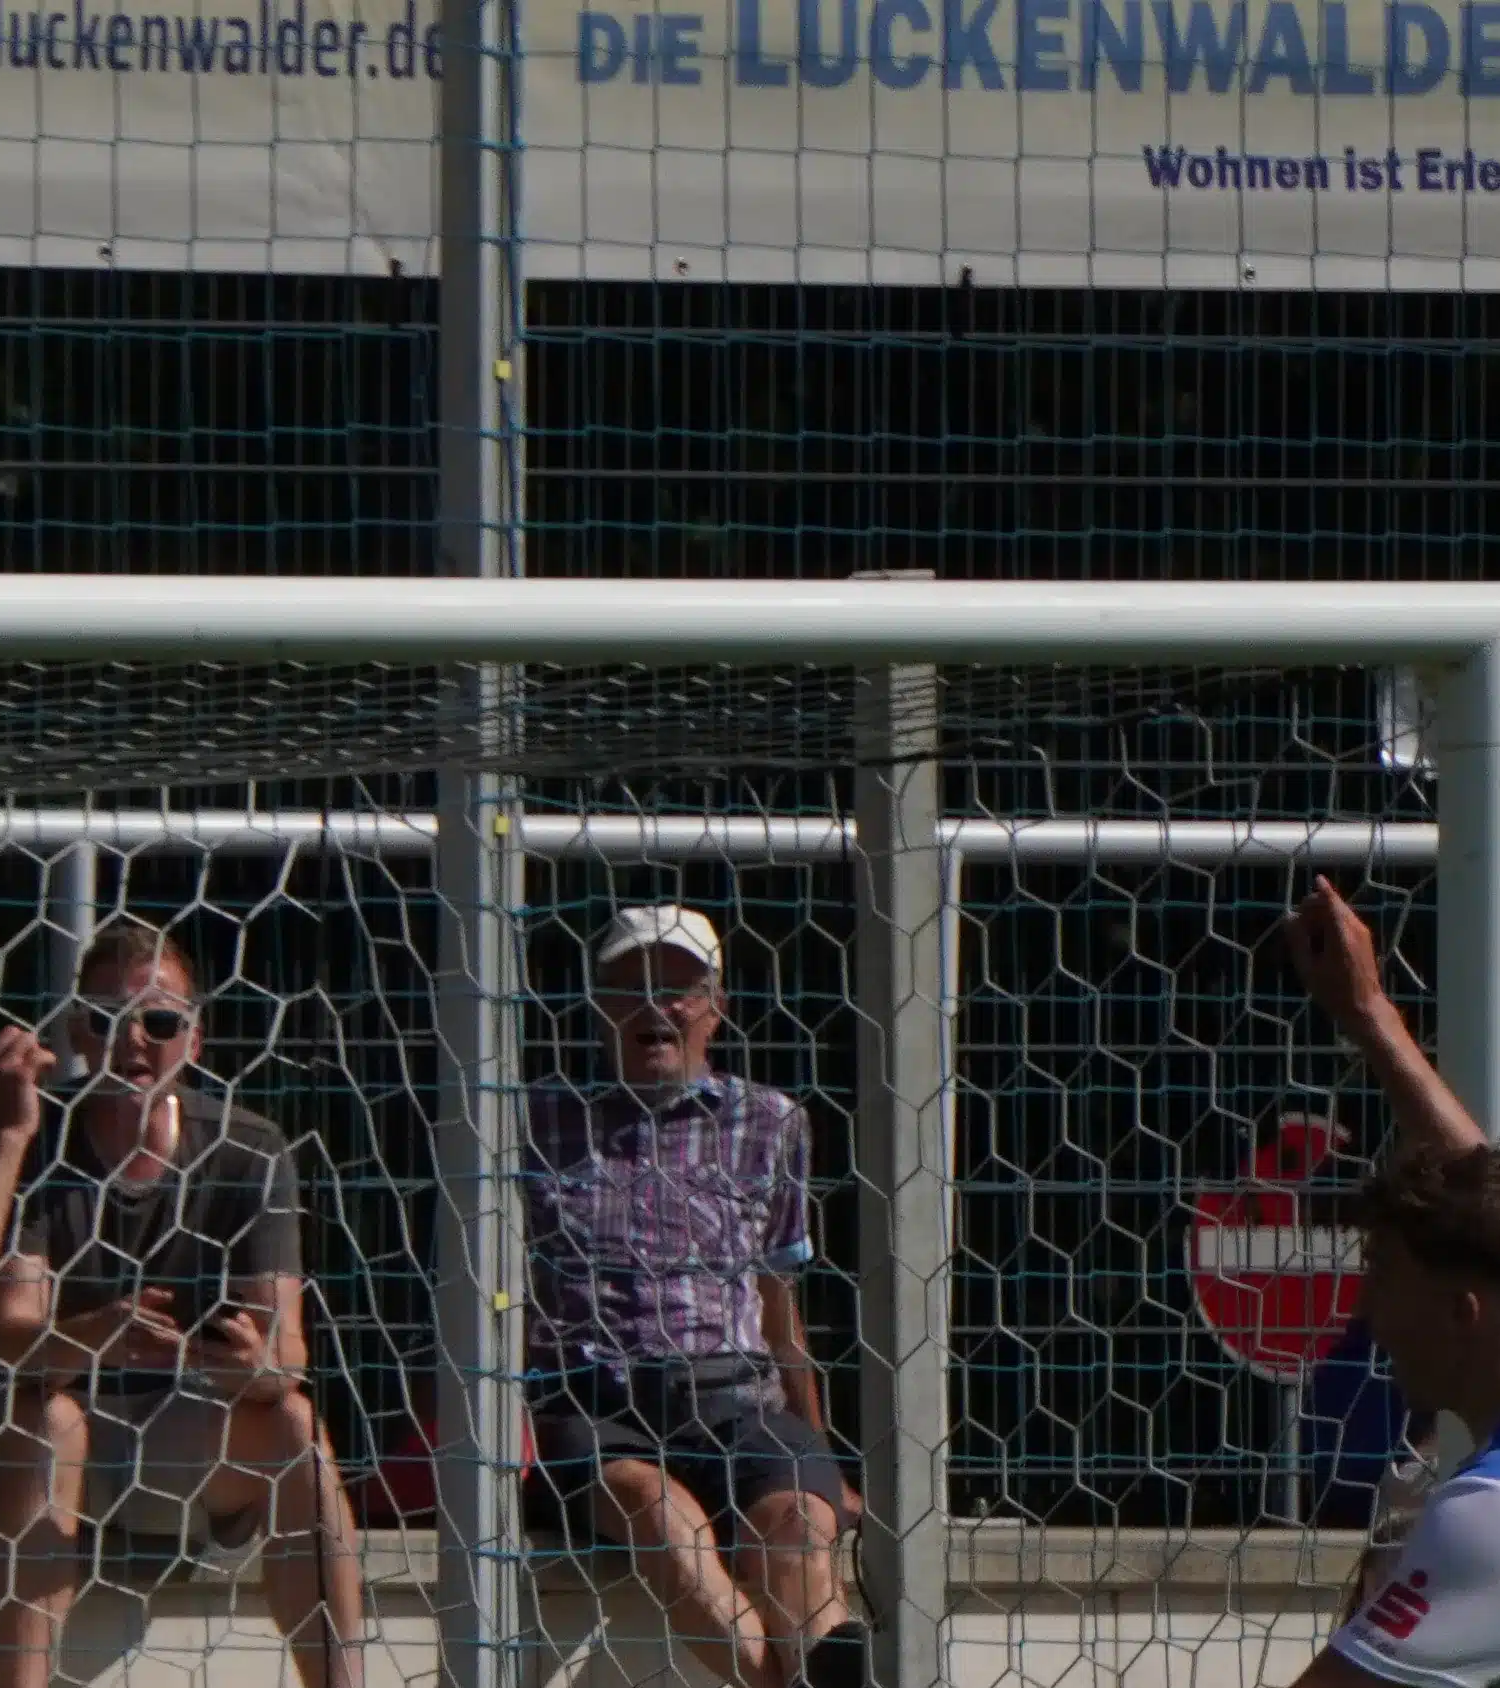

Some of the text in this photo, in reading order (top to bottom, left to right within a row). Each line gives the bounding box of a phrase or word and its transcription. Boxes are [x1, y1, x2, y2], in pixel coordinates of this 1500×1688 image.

[576, 12, 703, 86] DIE
[1143, 143, 1330, 192] Wohnen
[1344, 146, 1400, 192] ist
